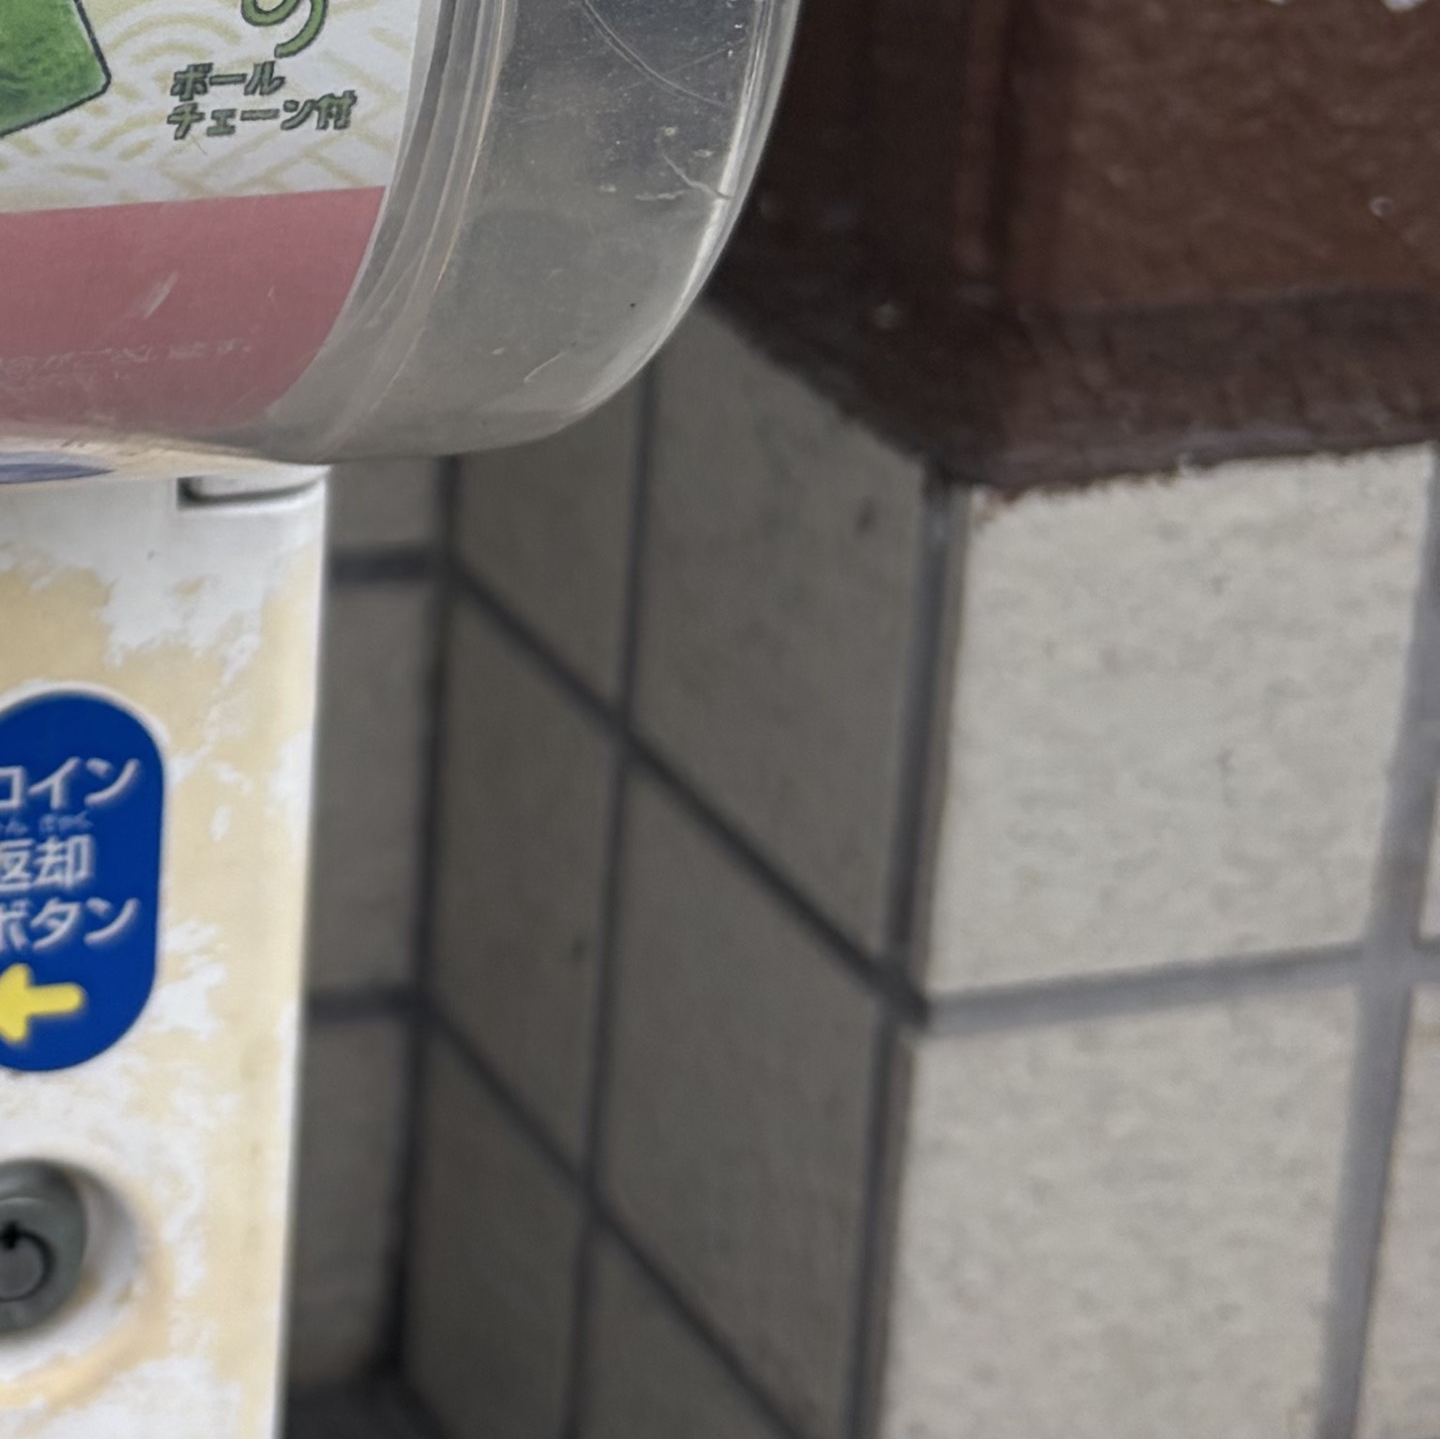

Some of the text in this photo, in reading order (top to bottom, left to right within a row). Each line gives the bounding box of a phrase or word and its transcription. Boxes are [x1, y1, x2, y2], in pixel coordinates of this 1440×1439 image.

[170, 60, 286, 102] ボール
[167, 89, 357, 140] チェーン付
